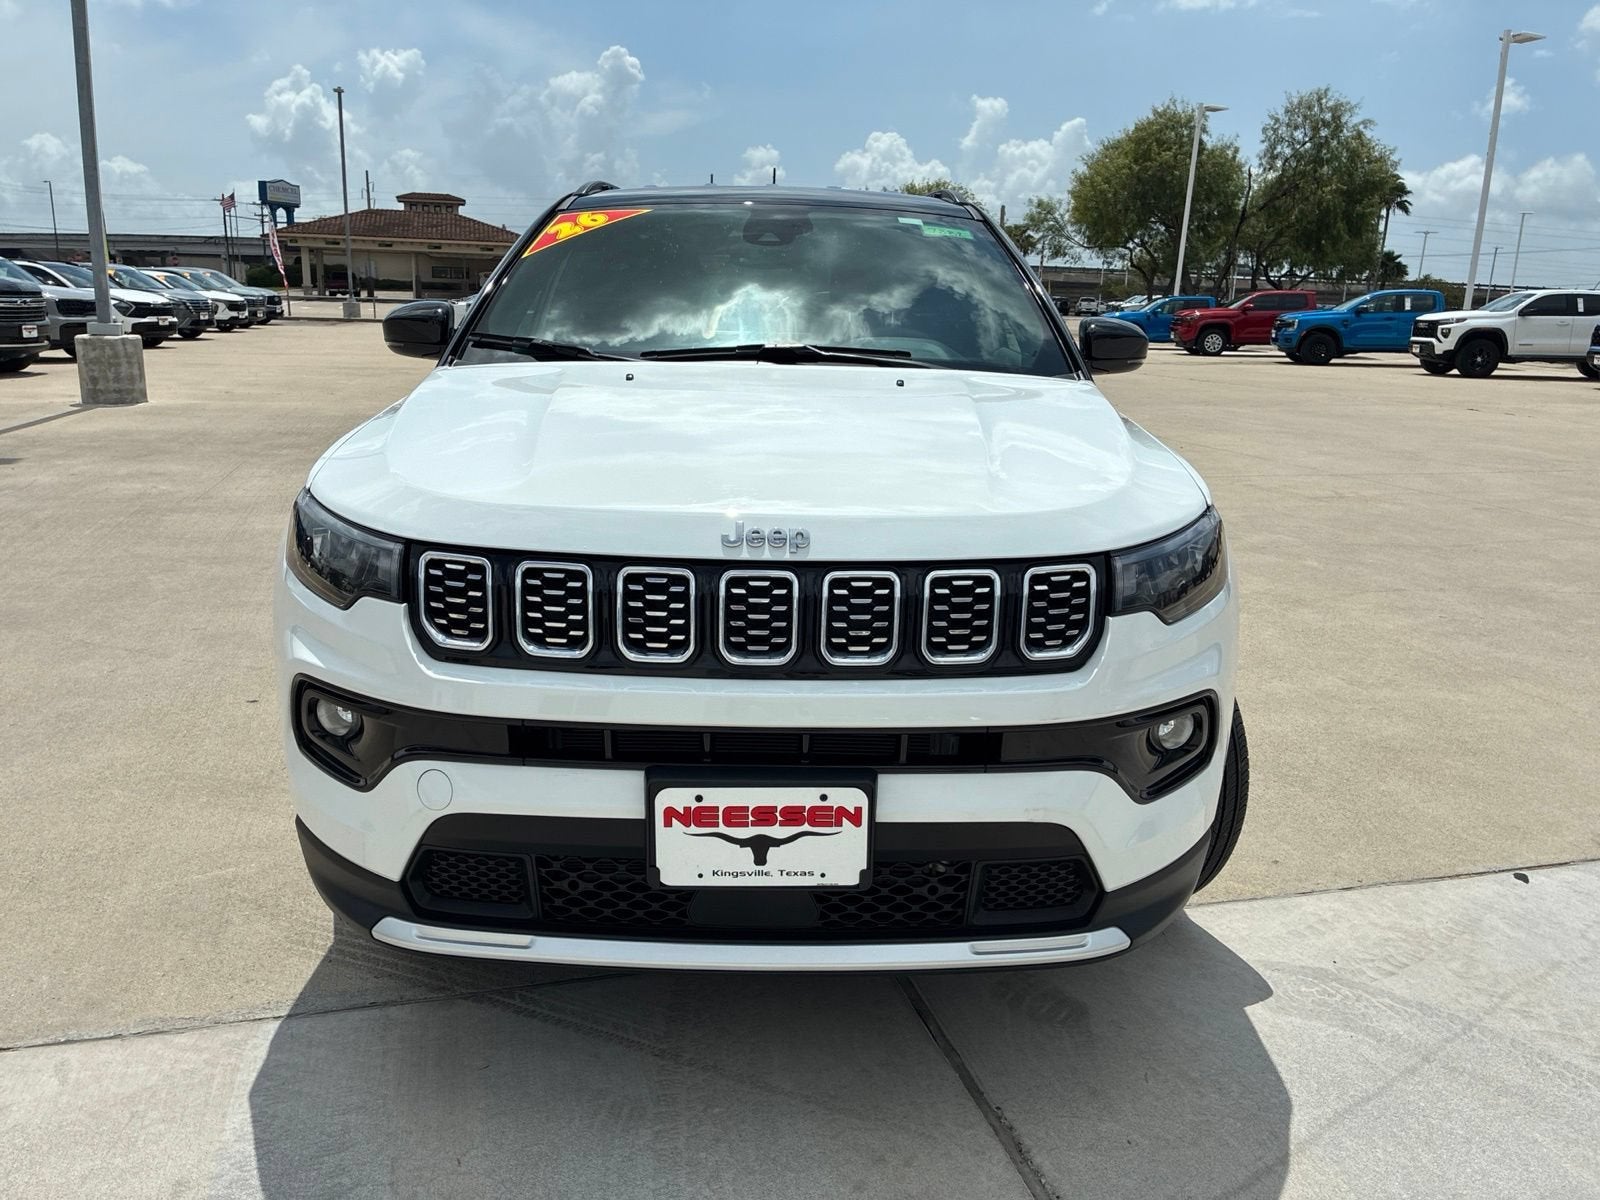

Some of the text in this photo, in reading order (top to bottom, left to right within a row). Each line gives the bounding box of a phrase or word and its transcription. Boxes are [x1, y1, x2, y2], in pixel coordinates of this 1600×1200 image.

[546, 212, 609, 240] 26
[721, 520, 811, 553] Jeep
[663, 805, 863, 828] NEESSEN
[712, 869, 815, 879] Kingsville, Texas
